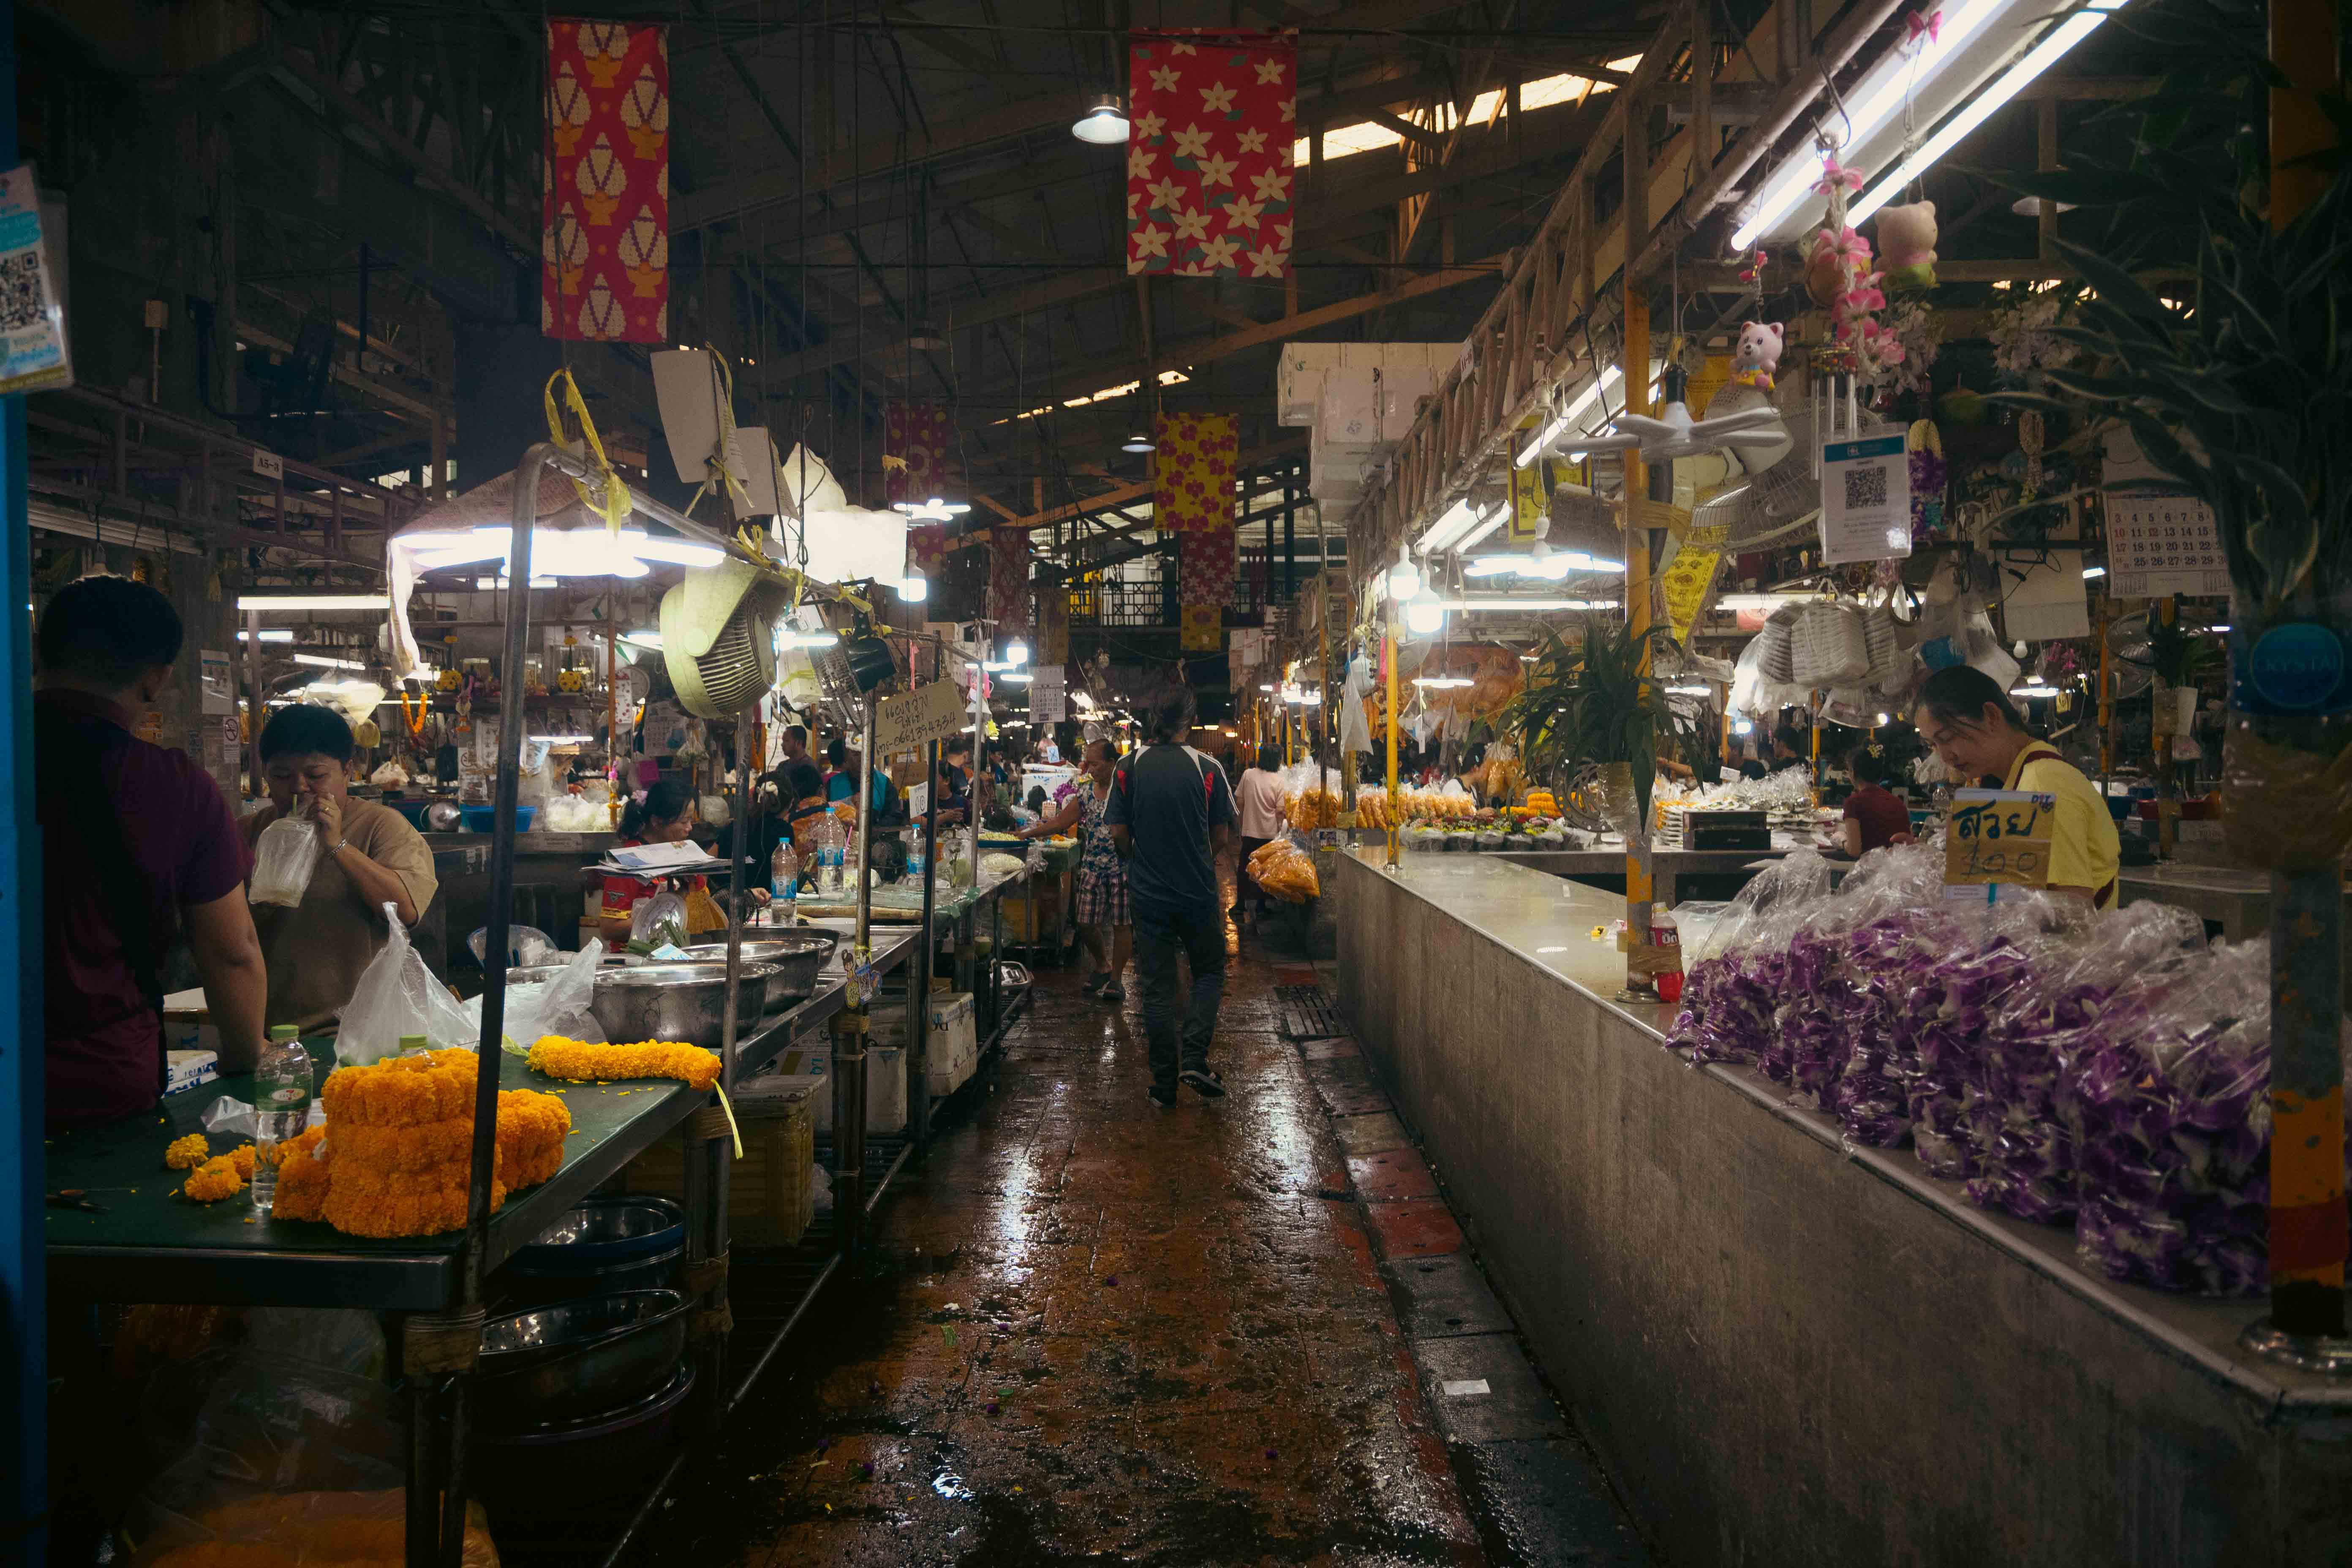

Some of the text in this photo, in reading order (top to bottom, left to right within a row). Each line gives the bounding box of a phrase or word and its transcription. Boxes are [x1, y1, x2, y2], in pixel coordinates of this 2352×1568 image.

[2115, 512, 2204, 523] 3 4 5 6 7 8
[2115, 527, 2208, 537] 10 11 12 13 14 15
[2115, 543, 2127, 552] 17
[2133, 542, 2144, 552] 18
[2150, 542, 2161, 551] 19
[2166, 542, 2178, 551] 20
[2183, 542, 2194, 550] 21
[2199, 541, 2211, 550] 22
[2134, 557, 2146, 566] 25
[2151, 557, 2163, 566] 26
[2167, 557, 2180, 566] 27
[2185, 556, 2197, 565] 28
[2201, 555, 2213, 565] 29
